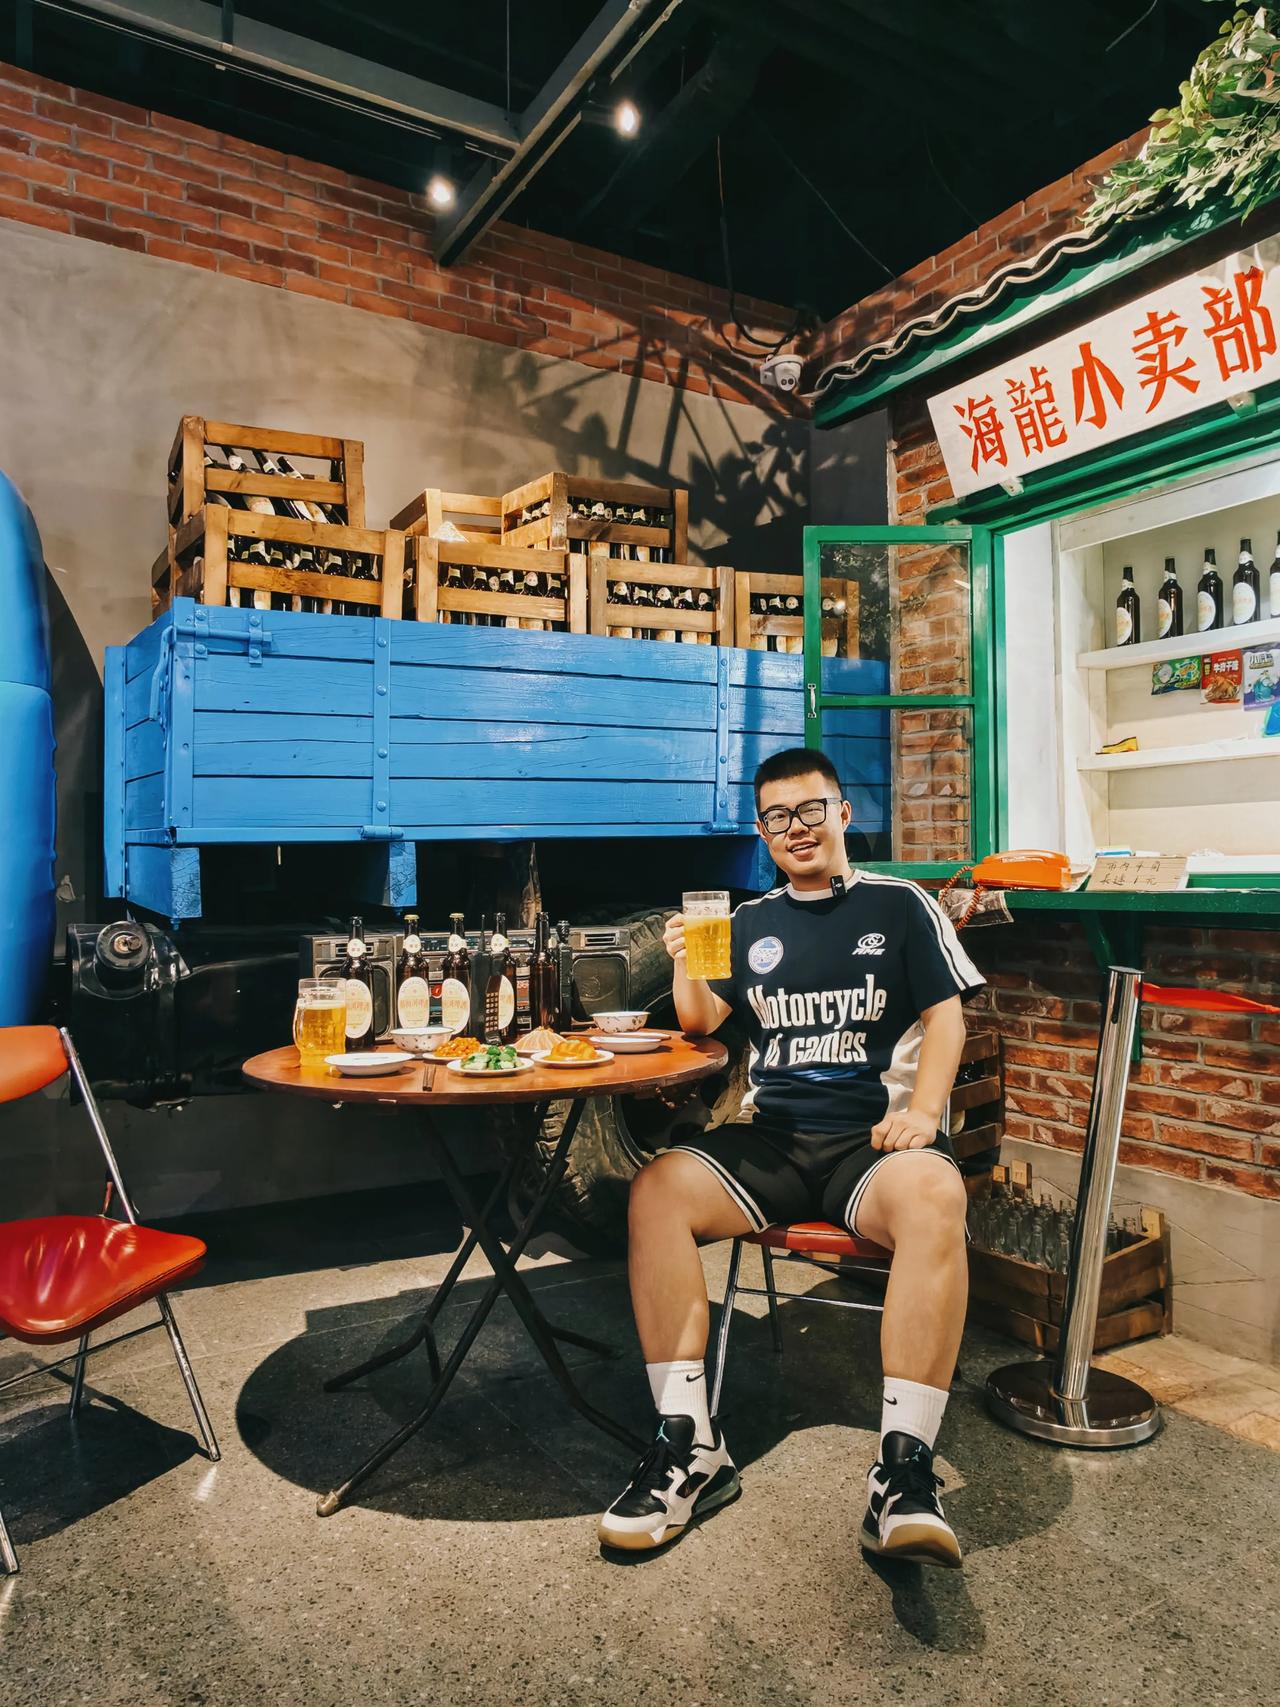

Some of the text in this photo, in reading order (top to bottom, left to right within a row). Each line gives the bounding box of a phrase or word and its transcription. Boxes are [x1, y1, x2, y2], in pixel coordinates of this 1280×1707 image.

[953, 266, 1279, 475] 海龍小卖部
[747, 974, 887, 1029] Motorcycle
